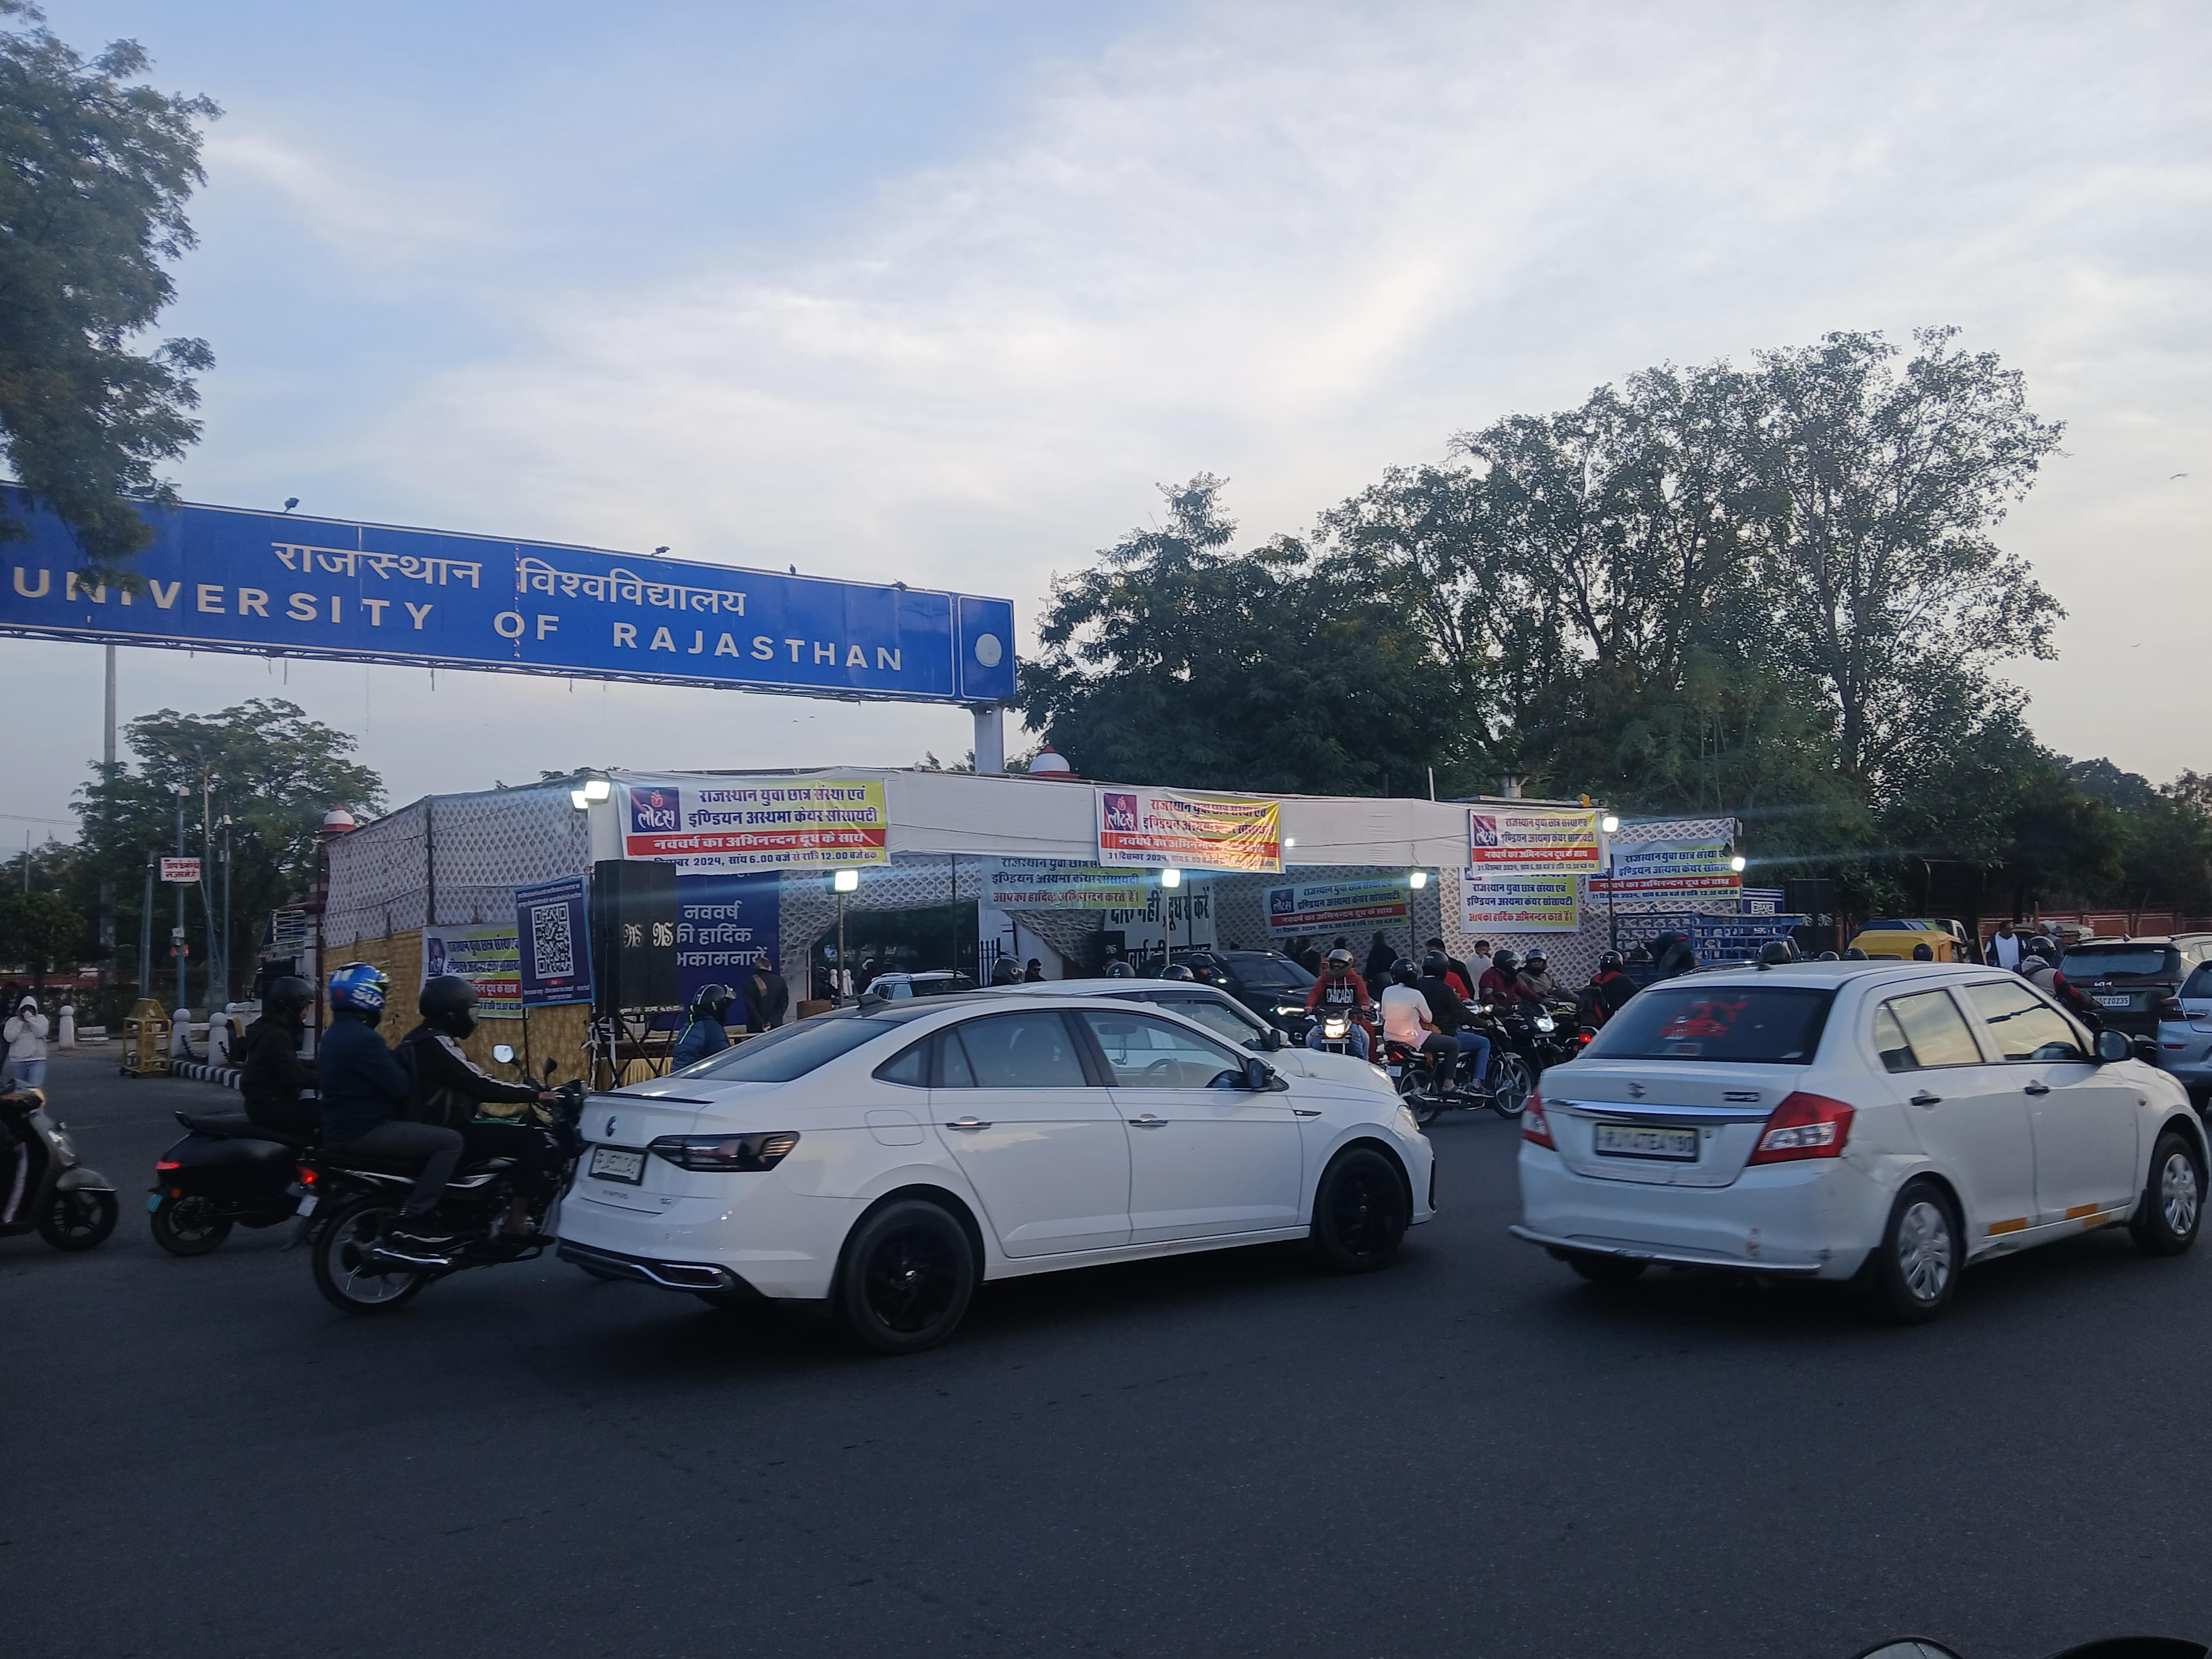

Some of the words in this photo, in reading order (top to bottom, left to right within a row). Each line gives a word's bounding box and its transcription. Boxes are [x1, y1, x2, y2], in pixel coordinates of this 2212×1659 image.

[271, 542, 483, 589] राजस्थान
[518, 557, 747, 617] विश्वविद्यालय
[14, 566, 433, 630] UNIVERSITY
[494, 610, 559, 640] OF
[613, 622, 902, 672] RAJASTHAN
[698, 790, 758, 803] राजस्थान
[760, 789, 785, 806] युवा
[787, 788, 811, 801] छात्र
[813, 785, 845, 801] संस्था
[846, 785, 866, 801] एवं
[1150, 799, 1191, 812] राजस्थान
[638, 804, 675, 829] लोटस
[687, 809, 743, 828] इण्डियन
[747, 811, 792, 824] अस्थमा
[794, 807, 824, 823] केयर
[826, 806, 878, 822] सोसायटी
[1108, 807, 1135, 829] लोटस
[1142, 815, 1180, 830] इण्डियन
[1506, 818, 1534, 827] राजस्थान
[1535, 818, 1548, 830] युवा
[653, 835, 700, 850] नववर्ष
[703, 838, 723, 848] का
[725, 834, 797, 847] अभिनन्दन
[799, 834, 821, 847] दूध
[821, 831, 837, 843] के
[838, 833, 865, 844] साथ
[1118, 835, 1152, 846] नववर्ष
[1153, 838, 1167, 847] का
[1501, 831, 1527, 844] इण्डियन
[693, 857, 725, 866] 2024,
[728, 854, 748, 865] सांय
[749, 854, 773, 864] 6.00
[775, 852, 790, 862] बजे
[792, 851, 800, 861] से
[801, 850, 819, 861] रात्रि
[821, 851, 847, 860] 12.00
[850, 849, 863, 859] बजे
[1119, 851, 1144, 860] दिसम्बर
[1146, 854, 1169, 862] 2024,
[1625, 853, 1661, 863] राजस्थान
[1661, 852, 1677, 863] युवा
[1001, 858, 1046, 867] राजस्थान
[1049, 859, 1066, 871] युवा
[991, 872, 1035, 884] इण्डियन
[1036, 873, 1070, 884] अस्थमा
[1618, 866, 1651, 877] इण्डियन
[1472, 884, 1504, 892] राजस्थान
[1506, 884, 1520, 895] युवा
[993, 892, 1026, 903] आपका
[1028, 890, 1056, 902] हार्दिक
[1104, 890, 1125, 902] करते
[1467, 896, 1496, 906] इण्डियन
[1497, 897, 1523, 906] अस्थमा
[683, 900, 743, 920] नववर्ष
[1297, 899, 1325, 910] इण्डियन
[1469, 913, 1492, 922] आपका
[697, 923, 754, 946] हार्दिक
[677, 946, 768, 967] भकामनायें
[1326, 988, 1354, 1004] CHICAGO
